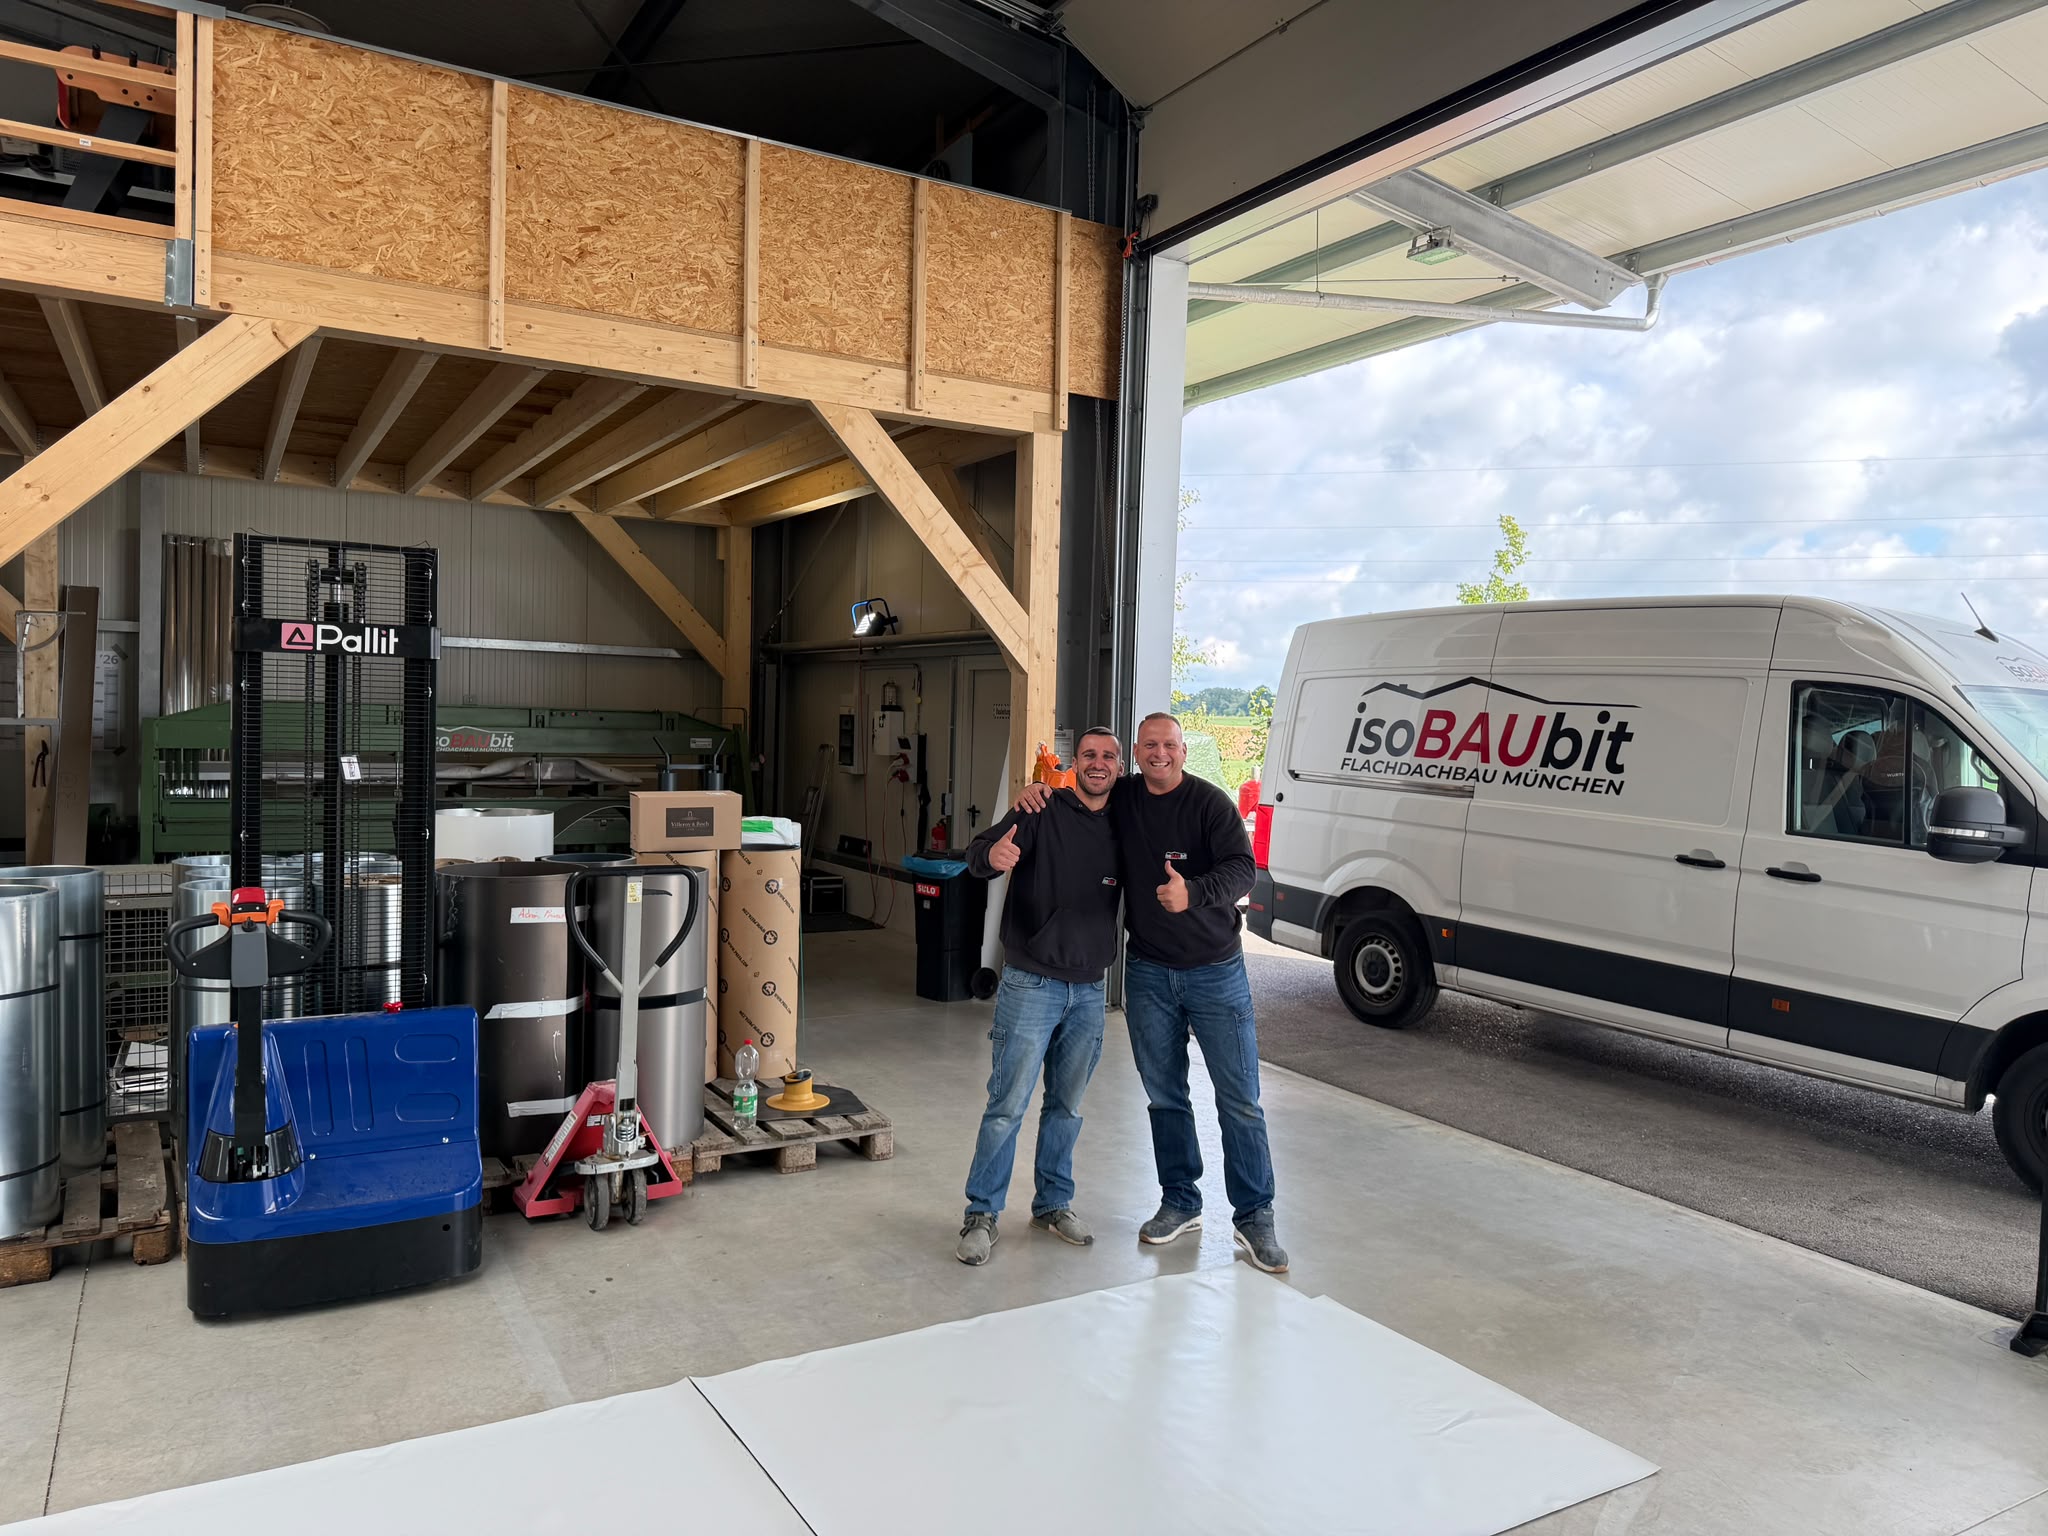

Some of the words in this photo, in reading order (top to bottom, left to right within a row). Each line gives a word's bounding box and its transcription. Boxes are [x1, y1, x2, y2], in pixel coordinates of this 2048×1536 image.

[316, 624, 399, 655] Pallit
[1345, 701, 1634, 775] isoBAUbit
[1340, 757, 1497, 784] FLACHDACHBAU
[1502, 768, 1625, 796] MÜNCHEN
[917, 884, 936, 895] SULO
